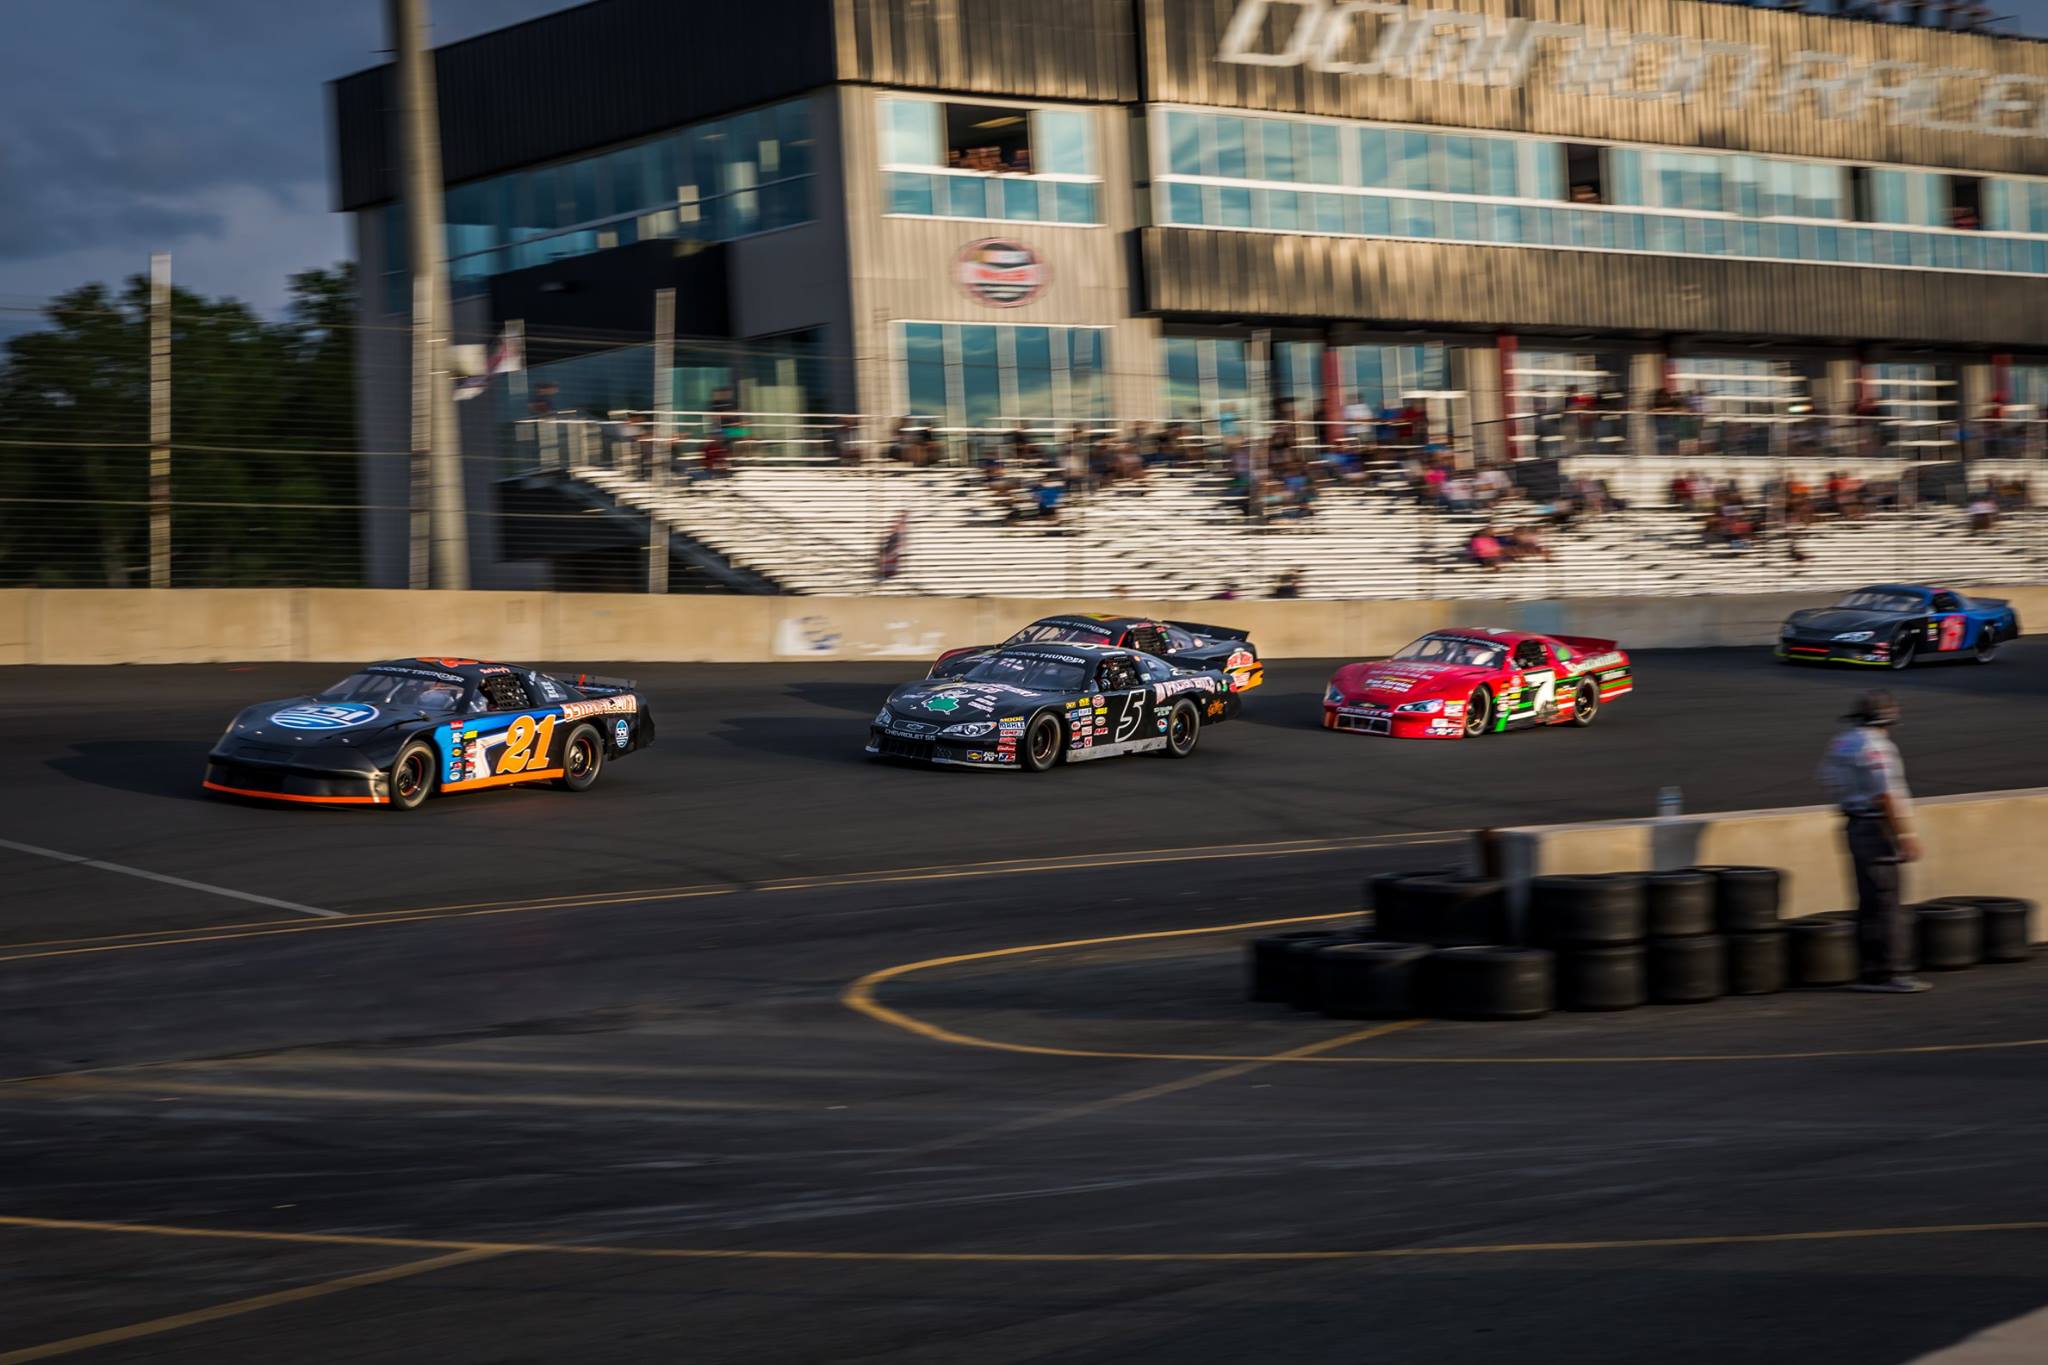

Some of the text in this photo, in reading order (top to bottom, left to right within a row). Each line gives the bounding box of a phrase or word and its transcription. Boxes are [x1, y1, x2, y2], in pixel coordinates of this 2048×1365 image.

[1040, 653, 1086, 664] THUNDER
[1115, 689, 1146, 742] 5
[496, 714, 556, 774] 21
[884, 729, 924, 740] CHEVROLET
